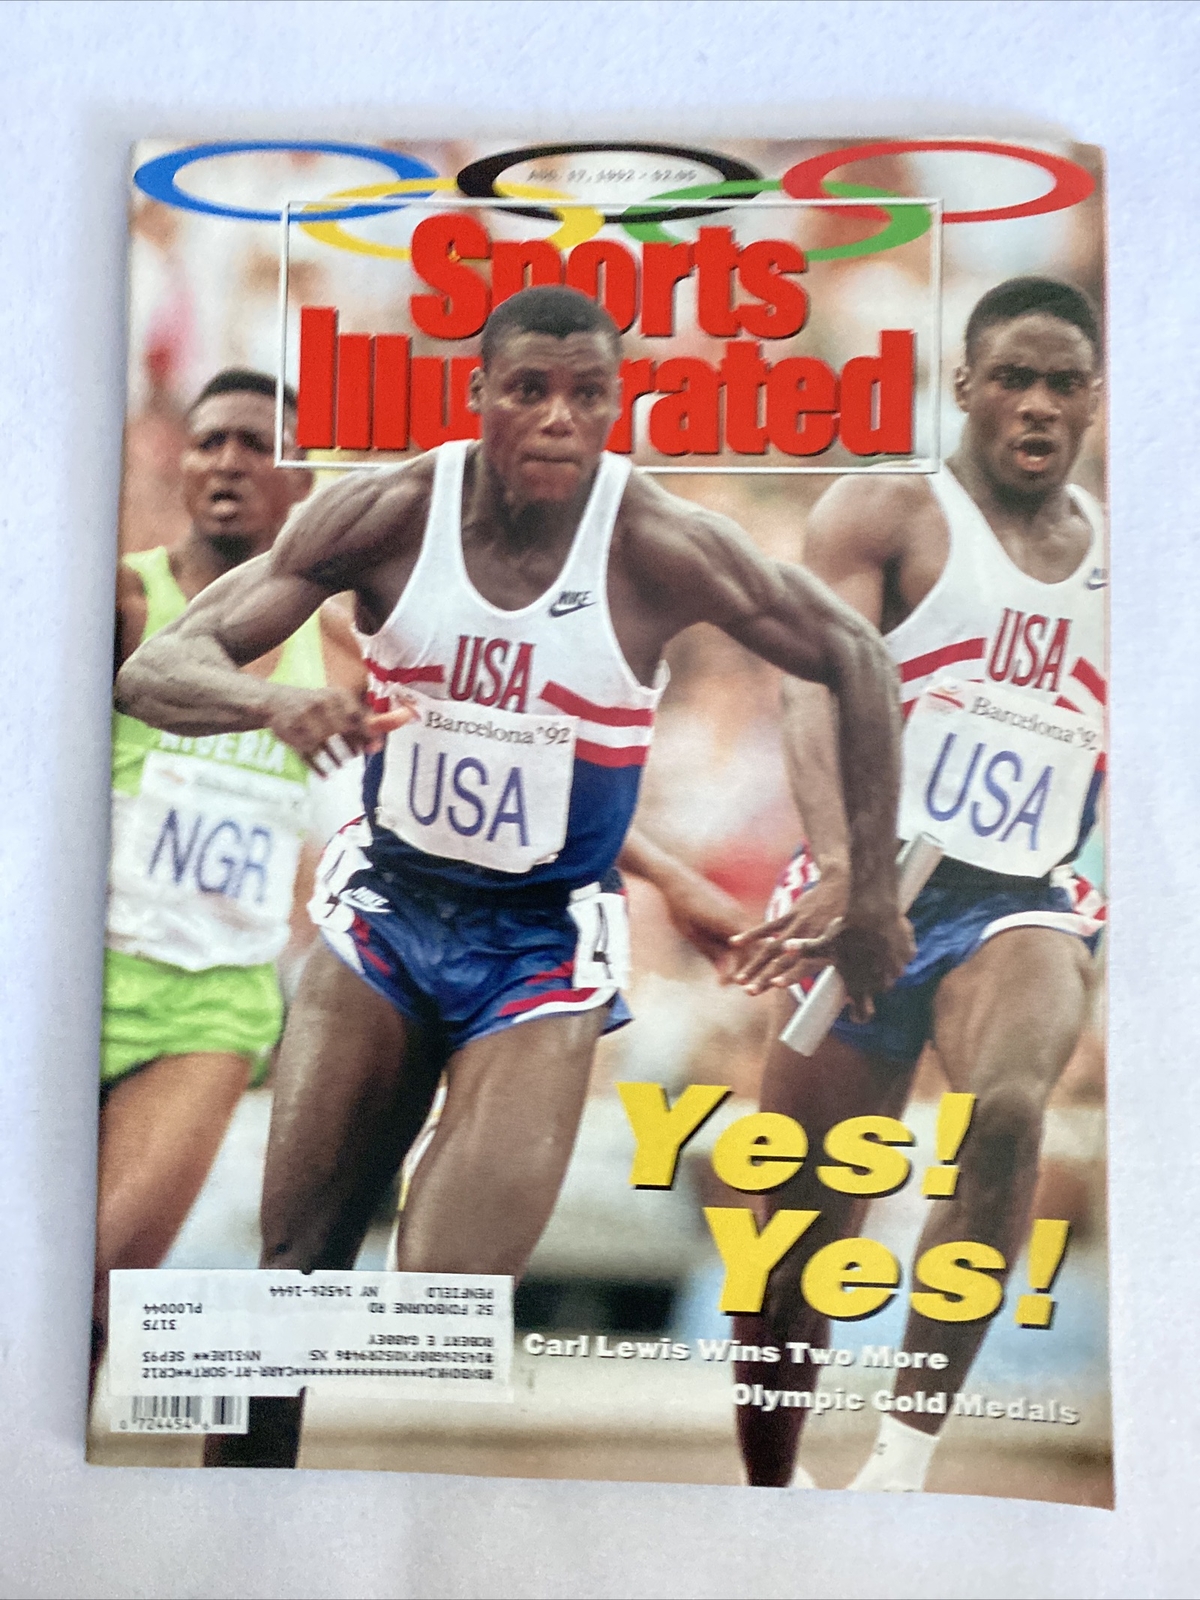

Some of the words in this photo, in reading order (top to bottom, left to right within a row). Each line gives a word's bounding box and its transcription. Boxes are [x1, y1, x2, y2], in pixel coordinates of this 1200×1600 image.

[297, 307, 914, 456] Illurated
[987, 607, 1073, 692] USA
[449, 634, 535, 713] USA
[425, 711, 534, 744] Barcelona
[408, 743, 530, 847] USA
[924, 732, 1055, 852] USA
[617, 1082, 976, 1197] Yes!
[704, 1207, 1070, 1327] Yes!
[360, 1286, 380, 1298] NY
[367, 1302, 386, 1314] RD
[476, 1304, 495, 1316] 52
[142, 1319, 177, 1331] 3175
[425, 1335, 436, 1347] E
[442, 1336, 495, 1348] ROBERT
[523, 1334, 589, 1357] Carl
[597, 1336, 690, 1361] Lewis
[699, 1339, 782, 1364] Wins
[784, 1342, 853, 1367] Two
[861, 1345, 950, 1370] More
[733, 1383, 866, 1414] Olympic
[872, 1390, 949, 1415] Gold
[953, 1393, 1081, 1426] Medals
